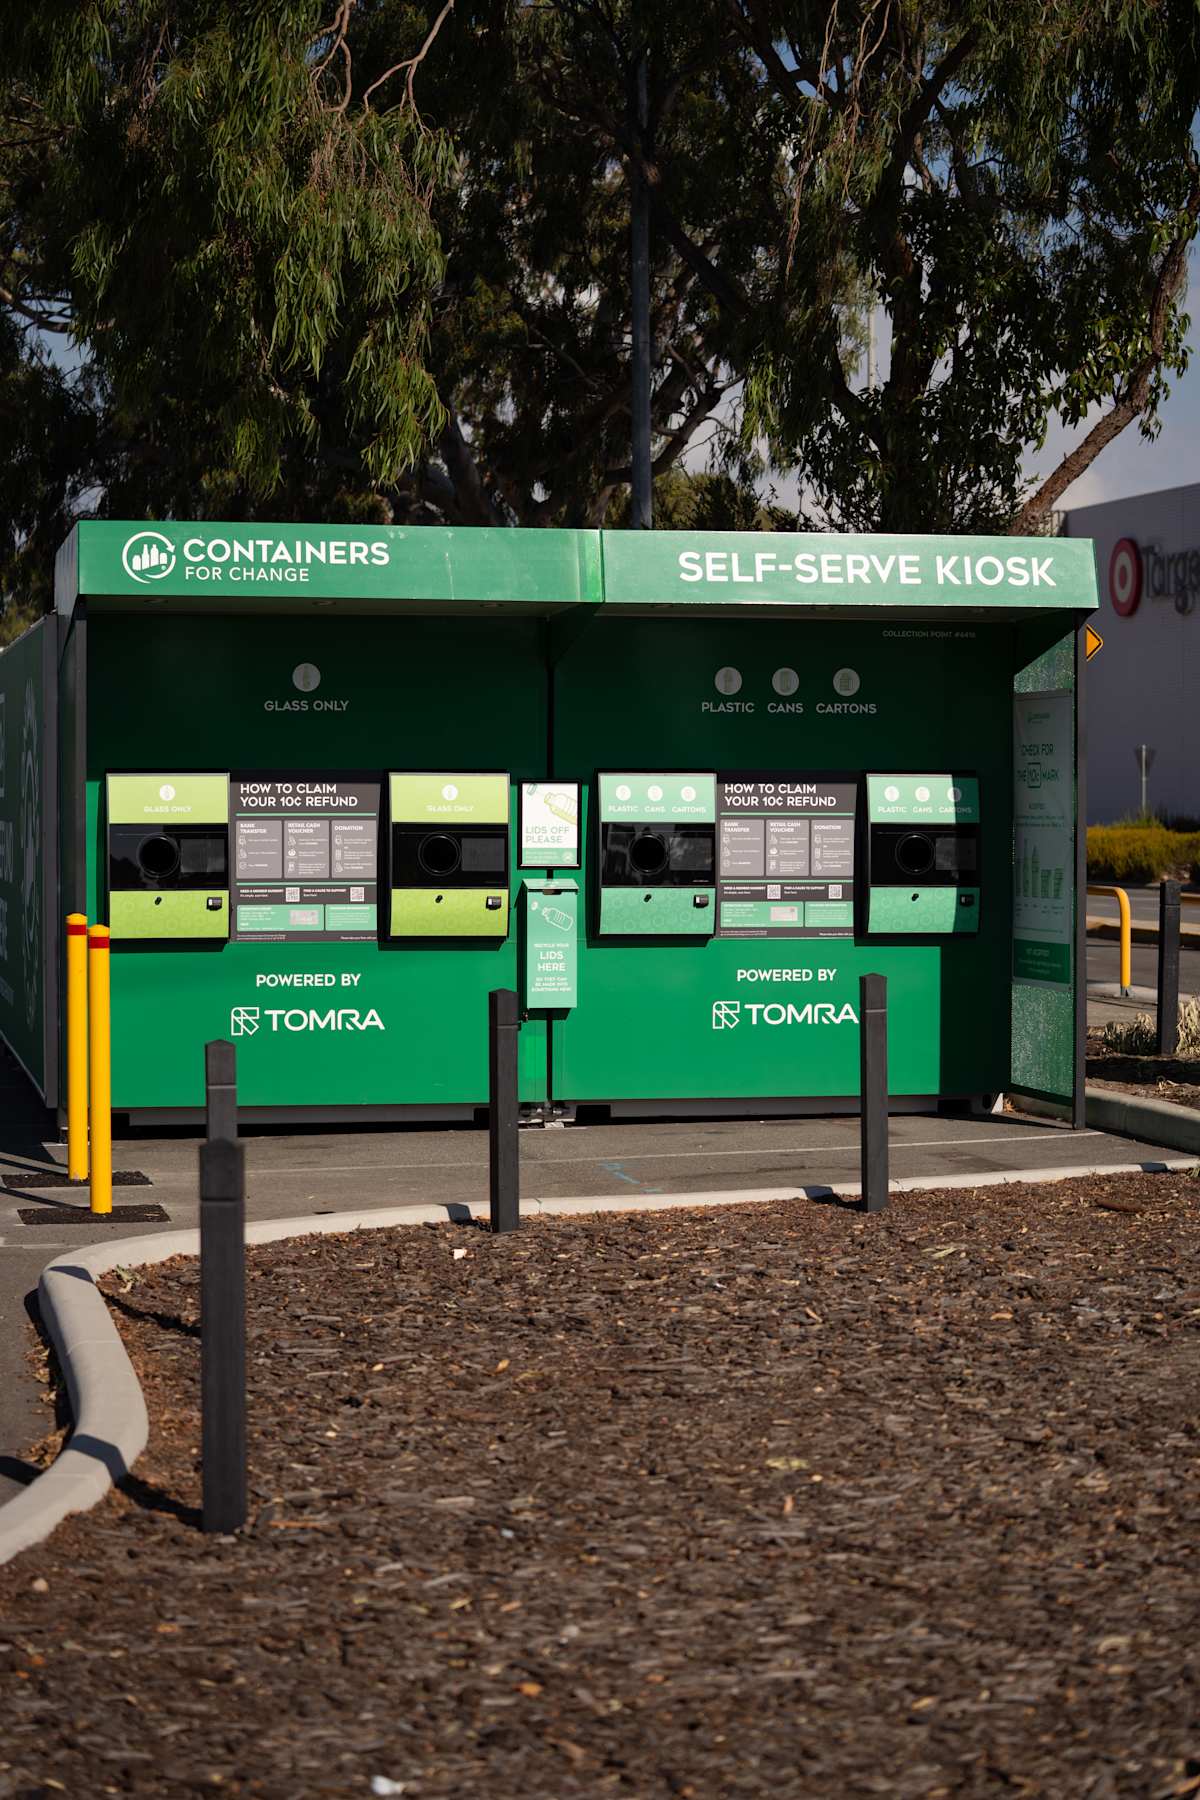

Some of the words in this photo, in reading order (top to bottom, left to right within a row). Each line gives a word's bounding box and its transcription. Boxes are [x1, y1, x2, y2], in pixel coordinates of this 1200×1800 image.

[184, 538, 390, 567] CONTAINERS
[679, 551, 922, 585] SELF-SERVE
[936, 555, 1057, 587] KIOSK
[185, 567, 223, 581] FOR
[229, 567, 310, 583] CHANGE
[882, 630, 928, 638] COLLECTION
[264, 700, 308, 711] GLASS
[313, 700, 349, 711] ONLY
[701, 702, 755, 713] PLASTIC
[767, 702, 804, 713] CANS
[815, 702, 877, 714] CARTONS
[240, 783, 272, 794] HOW
[275, 783, 293, 793] TO
[296, 783, 337, 794] CLAIM
[725, 784, 757, 793] HOW
[760, 784, 775, 793] TO
[778, 784, 816, 794] CLAIM
[240, 796, 277, 807] YOUR
[306, 796, 358, 807] REFUND
[725, 796, 760, 807] YOUR
[787, 796, 836, 807] REFUND
[526, 827, 548, 835] LIDS
[550, 827, 569, 835] OFF
[526, 835, 562, 843] PLEASE
[540, 951, 564, 960] LIDS
[537, 962, 566, 972] HERE
[256, 974, 336, 987] POWERED
[341, 973, 361, 986] BY
[736, 969, 813, 982] POWERED
[818, 968, 837, 981] BY
[744, 1003, 860, 1025] TOMRA
[264, 1009, 385, 1031] TOMRA
